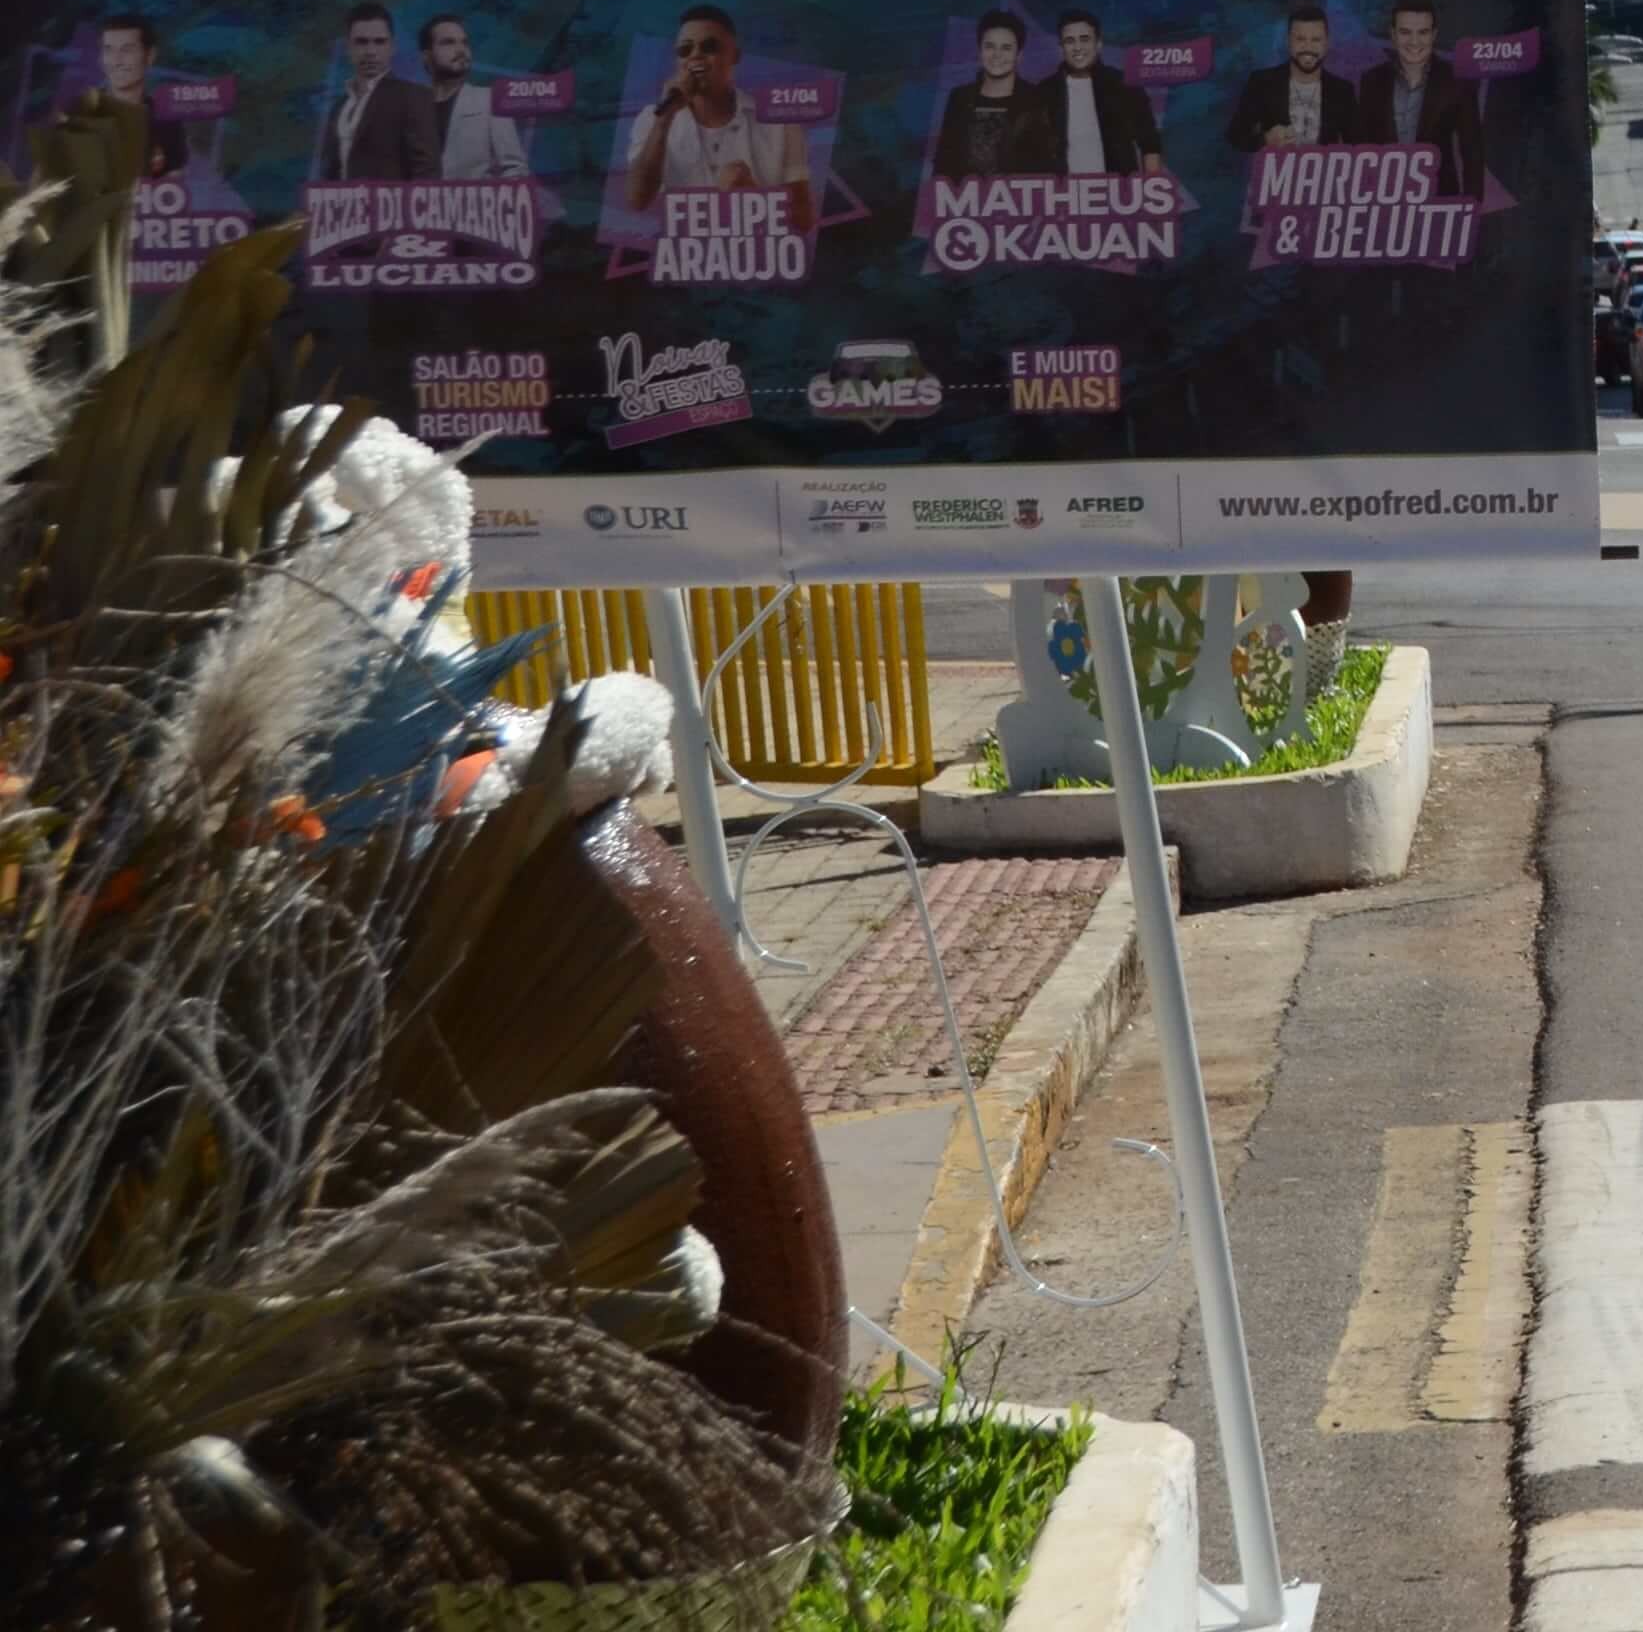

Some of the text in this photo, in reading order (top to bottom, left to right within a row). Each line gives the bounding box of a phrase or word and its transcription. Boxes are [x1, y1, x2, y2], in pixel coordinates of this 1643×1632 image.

[1142, 48, 1193, 65] 22/04
[1473, 42, 1523, 59] 23/04
[508, 80, 558, 98] 20/04
[770, 87, 819, 105] 21/04
[1258, 149, 1434, 207] MARCOS
[934, 177, 1176, 218] MATHEUS
[375, 186, 405, 233] DI
[410, 183, 534, 260] CAMARGO
[665, 191, 790, 237] FELIPE
[389, 234, 449, 259] &
[938, 220, 1176, 267] & KAUAN
[1276, 214, 1302, 254] &
[311, 261, 537, 287] LUCIANO
[415, 349, 546, 381] SALÃO DO
[1010, 347, 1119, 375] E MUITO
[414, 379, 549, 409] TURISMO
[807, 375, 942, 412] GAMES
[1012, 375, 1119, 413] MAIS!
[417, 411, 551, 438] REGIONAL
[620, 506, 689, 530] URI
[912, 498, 1003, 512] FREDERICO
[914, 511, 1005, 524] WESTPHALEN
[1066, 496, 1146, 514] AFRED
[1219, 487, 1560, 522] www.expofred.com.br
